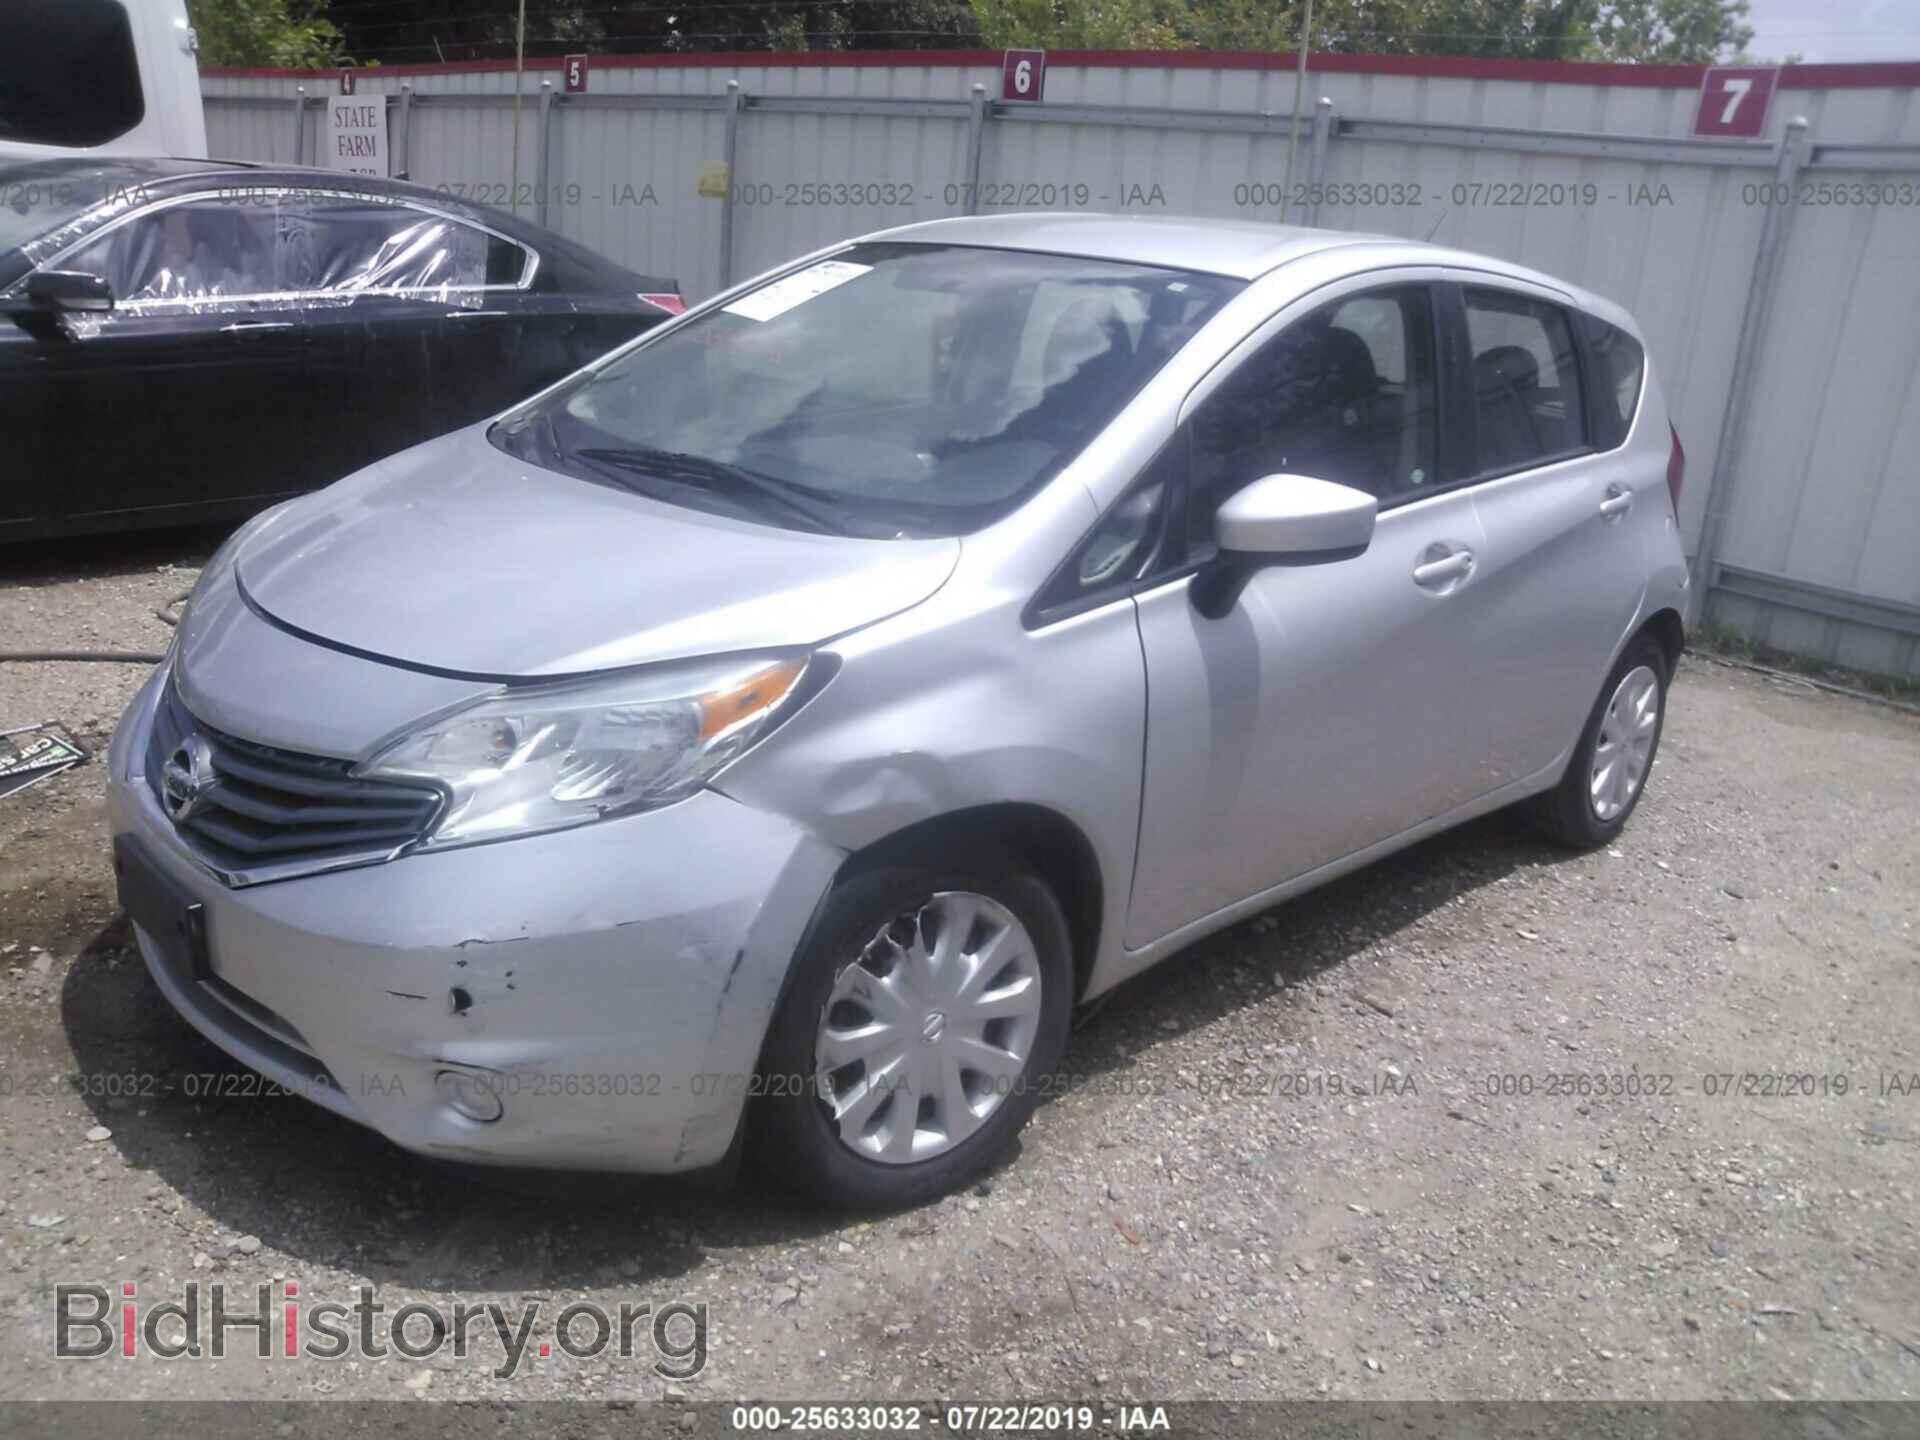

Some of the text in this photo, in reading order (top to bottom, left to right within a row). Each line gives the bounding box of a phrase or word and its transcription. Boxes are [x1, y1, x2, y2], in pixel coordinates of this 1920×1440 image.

[571, 62, 580, 87] 5
[1015, 60, 1032, 94] 6
[1720, 79, 1753, 123] 7
[335, 105, 377, 128] STATE
[337, 135, 377, 157] FARM
